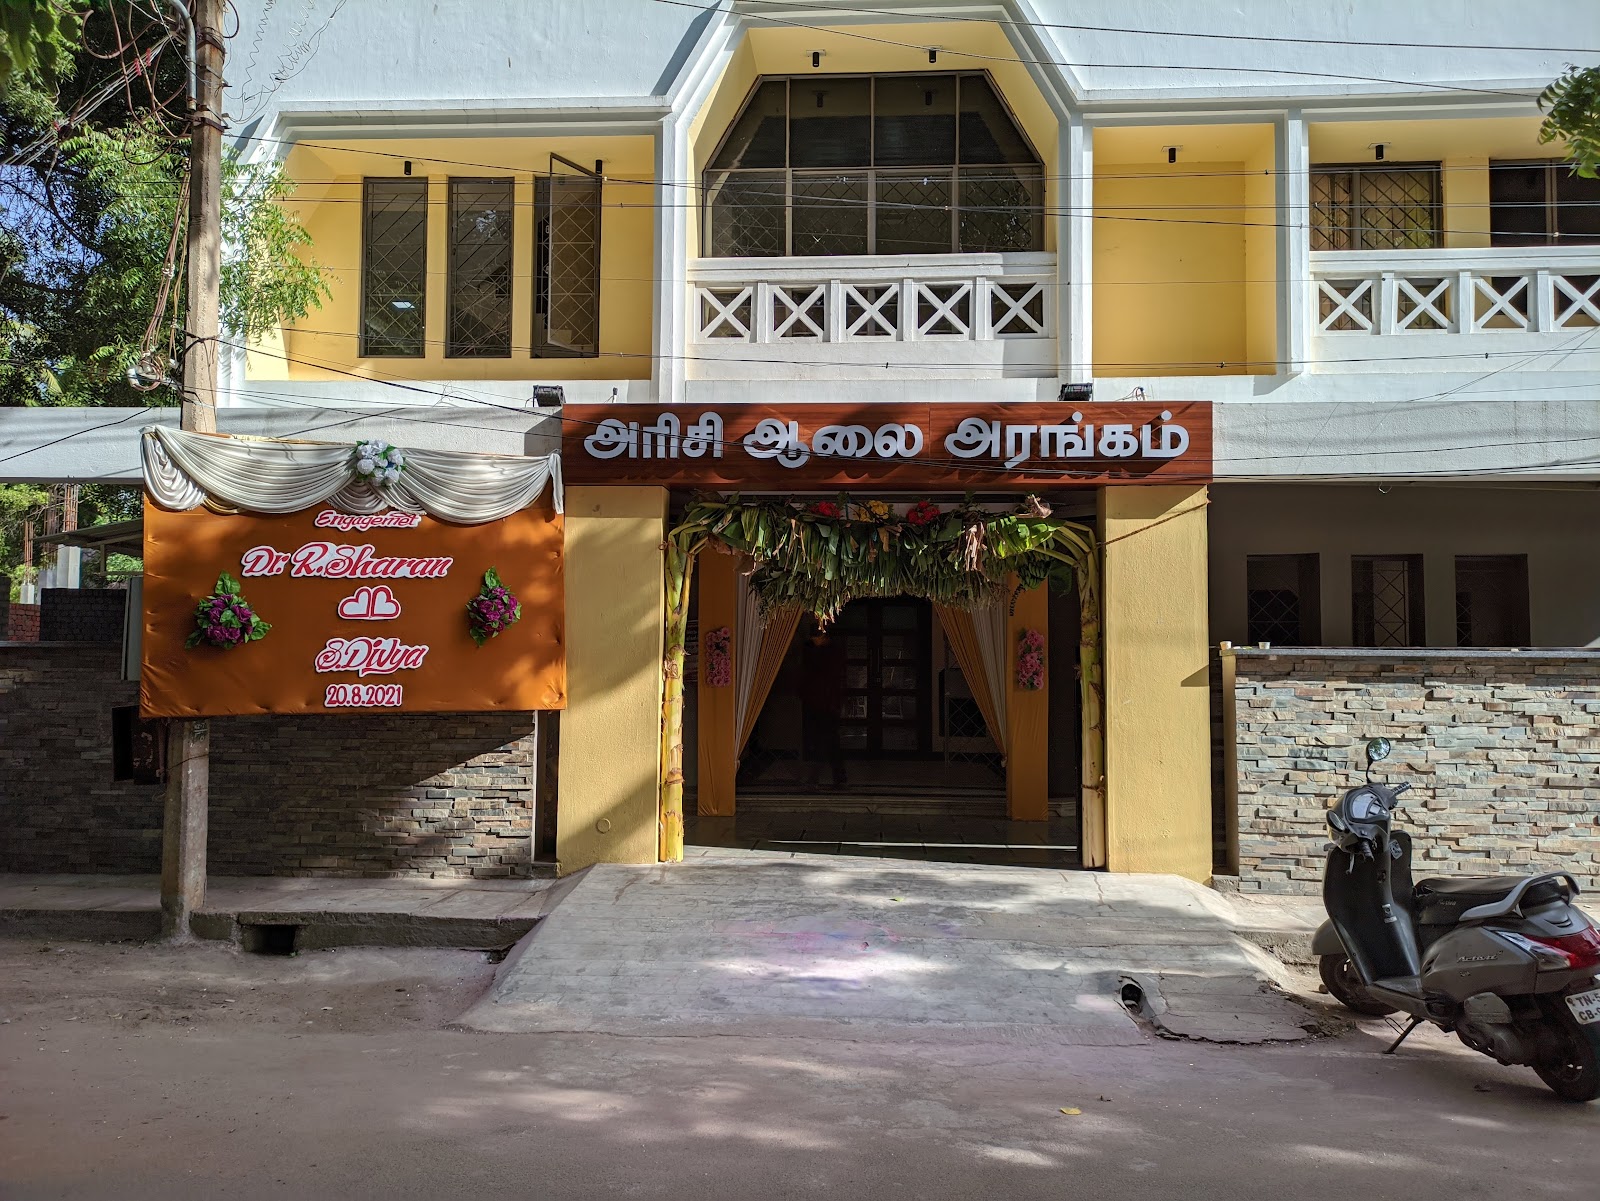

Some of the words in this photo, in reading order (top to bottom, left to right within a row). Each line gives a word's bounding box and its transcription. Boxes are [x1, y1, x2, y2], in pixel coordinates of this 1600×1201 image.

[584, 411, 724, 459] அரிசி
[743, 418, 923, 469] ஆலை
[945, 410, 1190, 469] அரங்கம்
[244, 547, 288, 574] Dr.
[317, 638, 426, 674] S.Divya
[327, 686, 402, 705] 20.8.2021
